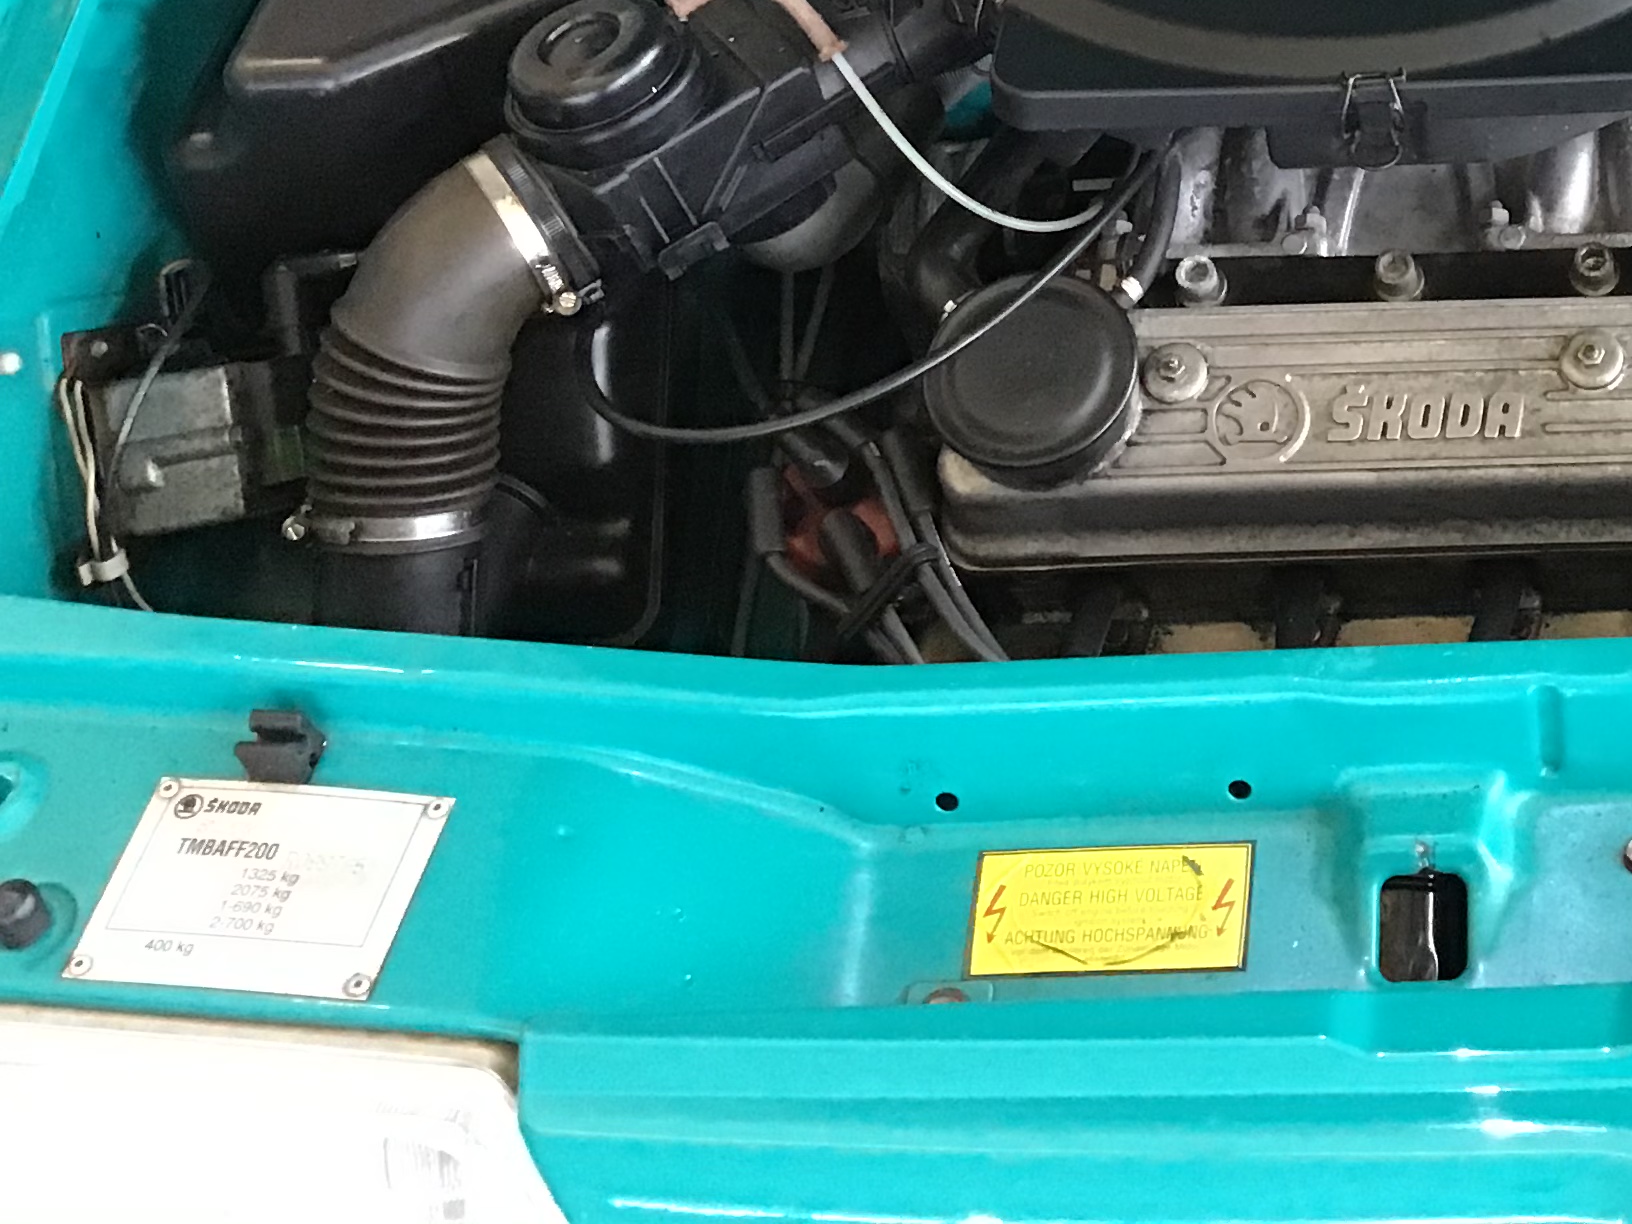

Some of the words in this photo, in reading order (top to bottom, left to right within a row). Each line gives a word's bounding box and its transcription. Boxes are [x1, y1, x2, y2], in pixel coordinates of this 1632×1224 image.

[176, 837, 280, 861] TMBAFF200
[241, 867, 278, 882] 1325
[280, 870, 301, 887] kg
[1024, 862, 1076, 878] POZOR
[230, 883, 270, 898] 2075
[272, 887, 292, 903] kg
[1019, 890, 1083, 907] DANGER
[1089, 888, 1128, 904] HIGH
[1135, 885, 1203, 903] VOLTAGE
[264, 902, 283, 919] kg
[256, 919, 275, 935] kg
[1004, 929, 1076, 945] ACHTUNG
[144, 939, 174, 952] 400
[176, 941, 195, 957] kg
